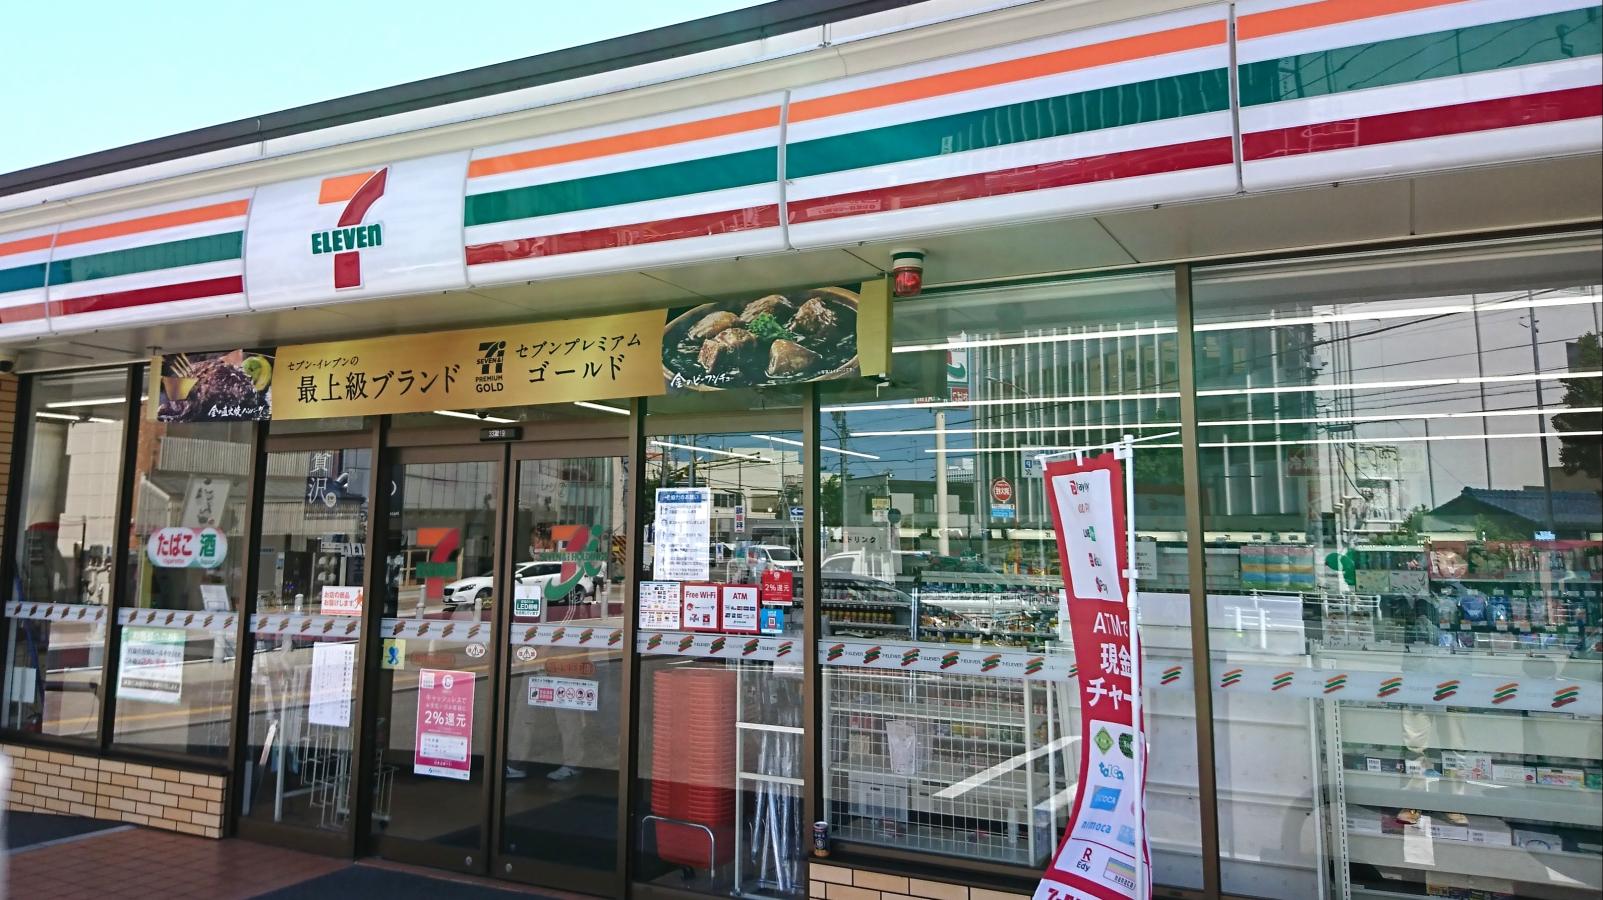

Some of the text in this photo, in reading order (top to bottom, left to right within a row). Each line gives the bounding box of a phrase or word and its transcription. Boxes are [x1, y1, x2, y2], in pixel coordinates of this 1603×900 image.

[515, 333, 641, 359] セブンプレミアム
[528, 354, 625, 383] ゴールド
[297, 364, 461, 404] 最上級ブランド
[475, 374, 503, 383] PREMIUM
[475, 382, 505, 393] GOLD
[156, 533, 217, 557] たばこ 酒
[685, 590, 716, 599] Free Wi-Fi
[764, 583, 791, 592] 2%還元
[732, 592, 748, 600] ATM
[1093, 611, 1129, 637] ATMで
[1100, 642, 1132, 678] 現金
[424, 710, 466, 728] 2%還元
[1081, 820, 1112, 834] nimoca
[1082, 847, 1093, 861] R
[1076, 861, 1091, 872] Edy
